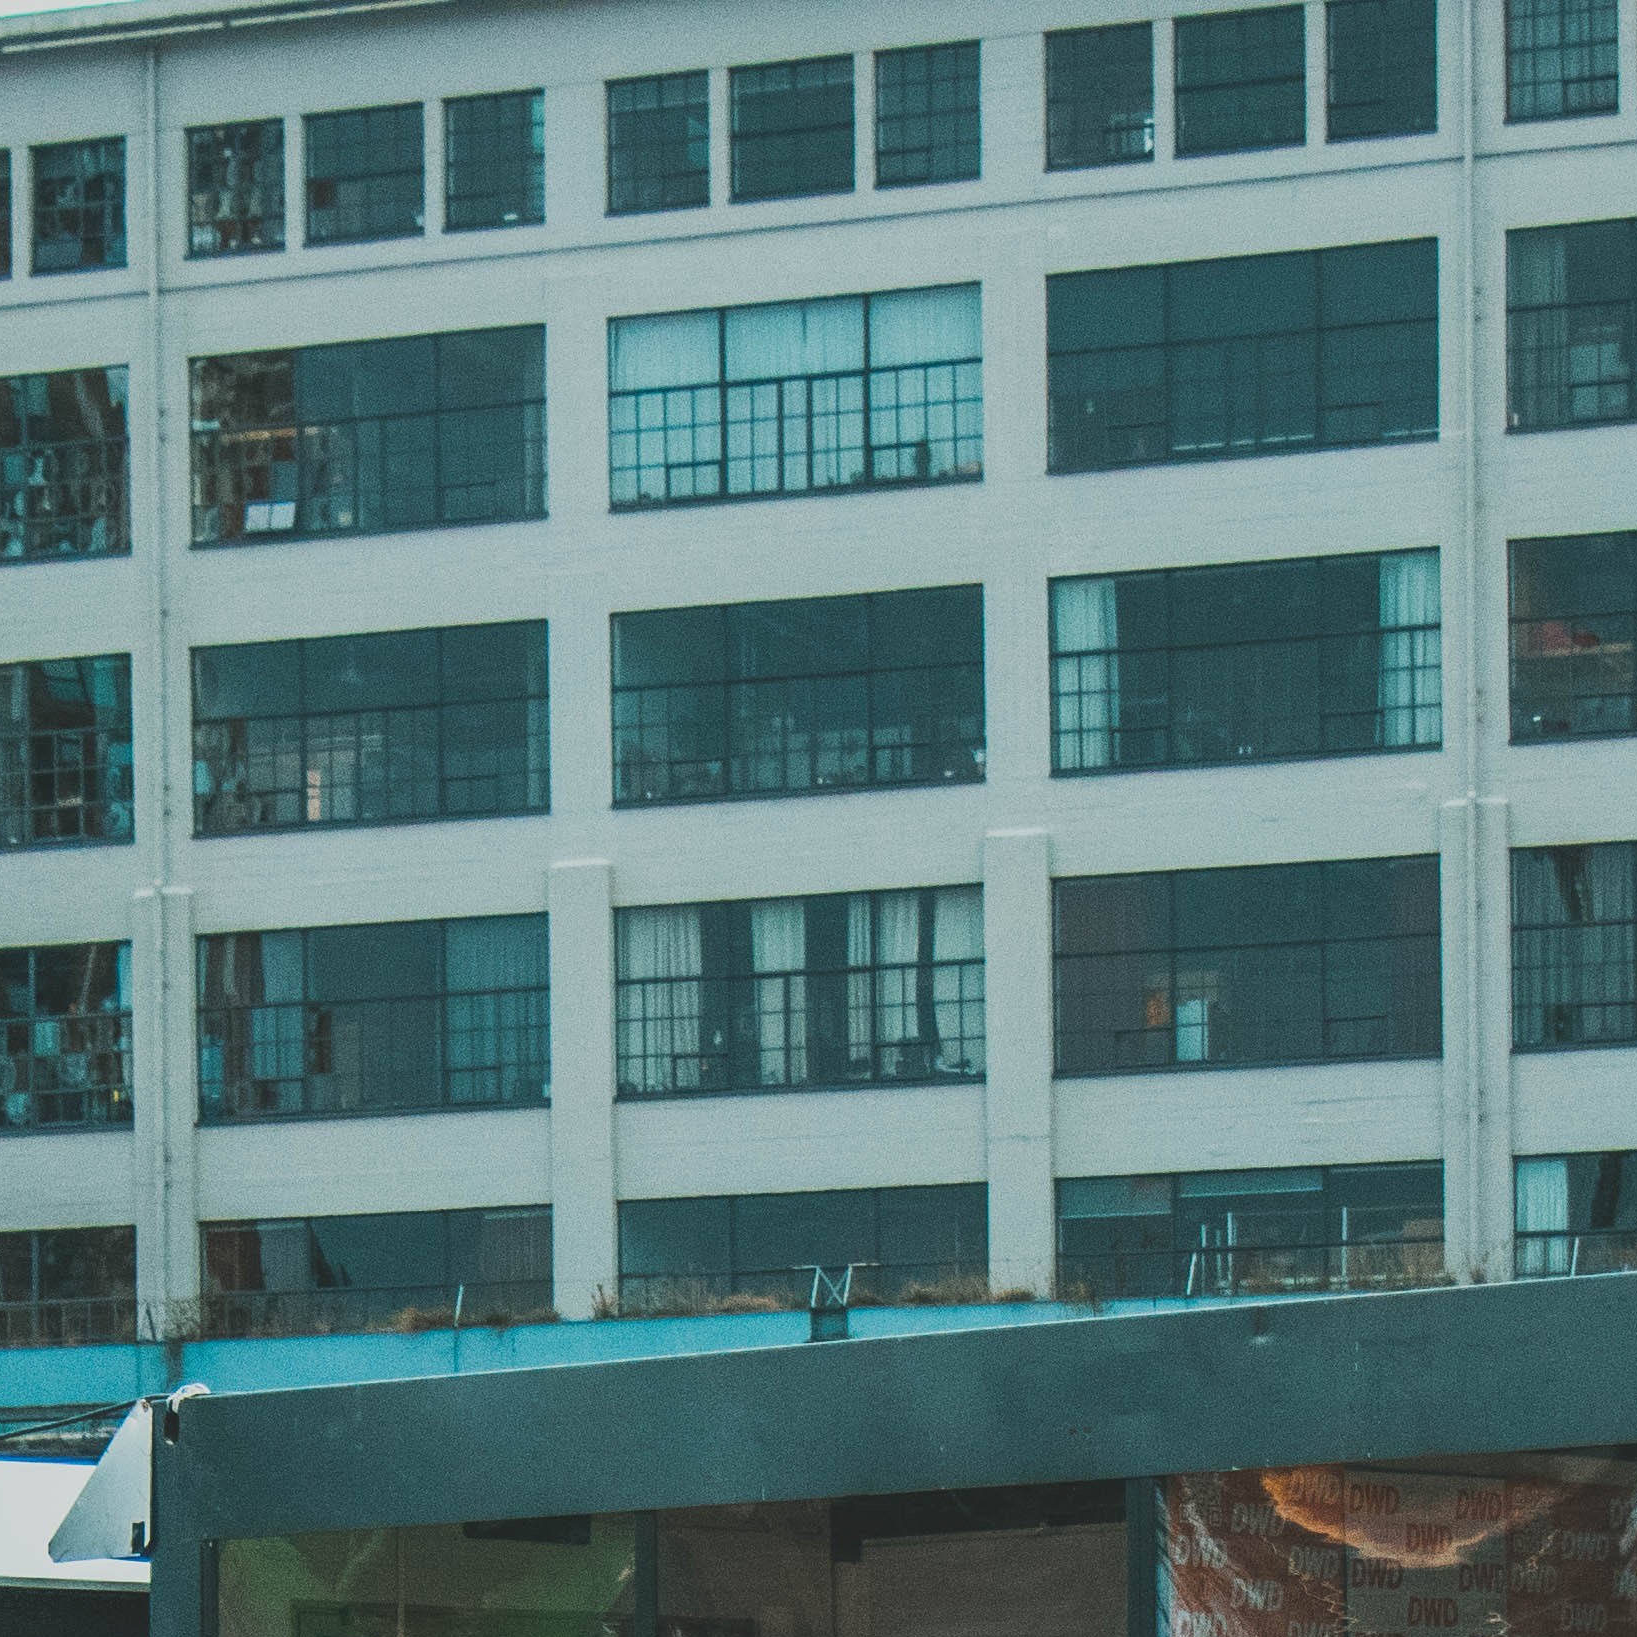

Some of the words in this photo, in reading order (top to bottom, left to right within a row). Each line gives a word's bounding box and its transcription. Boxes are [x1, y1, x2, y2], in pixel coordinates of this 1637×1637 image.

[1289, 1470, 1342, 1504] DWD
[1348, 1484, 1401, 1514] DWD
[1232, 1502, 1285, 1537] DWD
[1456, 1488, 1502, 1521] DWD
[1406, 1522, 1453, 1550] DWD
[1561, 1530, 1610, 1561] DWD
[1287, 1546, 1341, 1578] DWD
[1350, 1559, 1405, 1590] DWD
[1459, 1564, 1504, 1594] DWD
[1512, 1564, 1559, 1596] DWD
[1231, 1577, 1285, 1613] DWD
[1408, 1596, 1459, 1627] DWD
[1560, 1603, 1608, 1633] DWD
